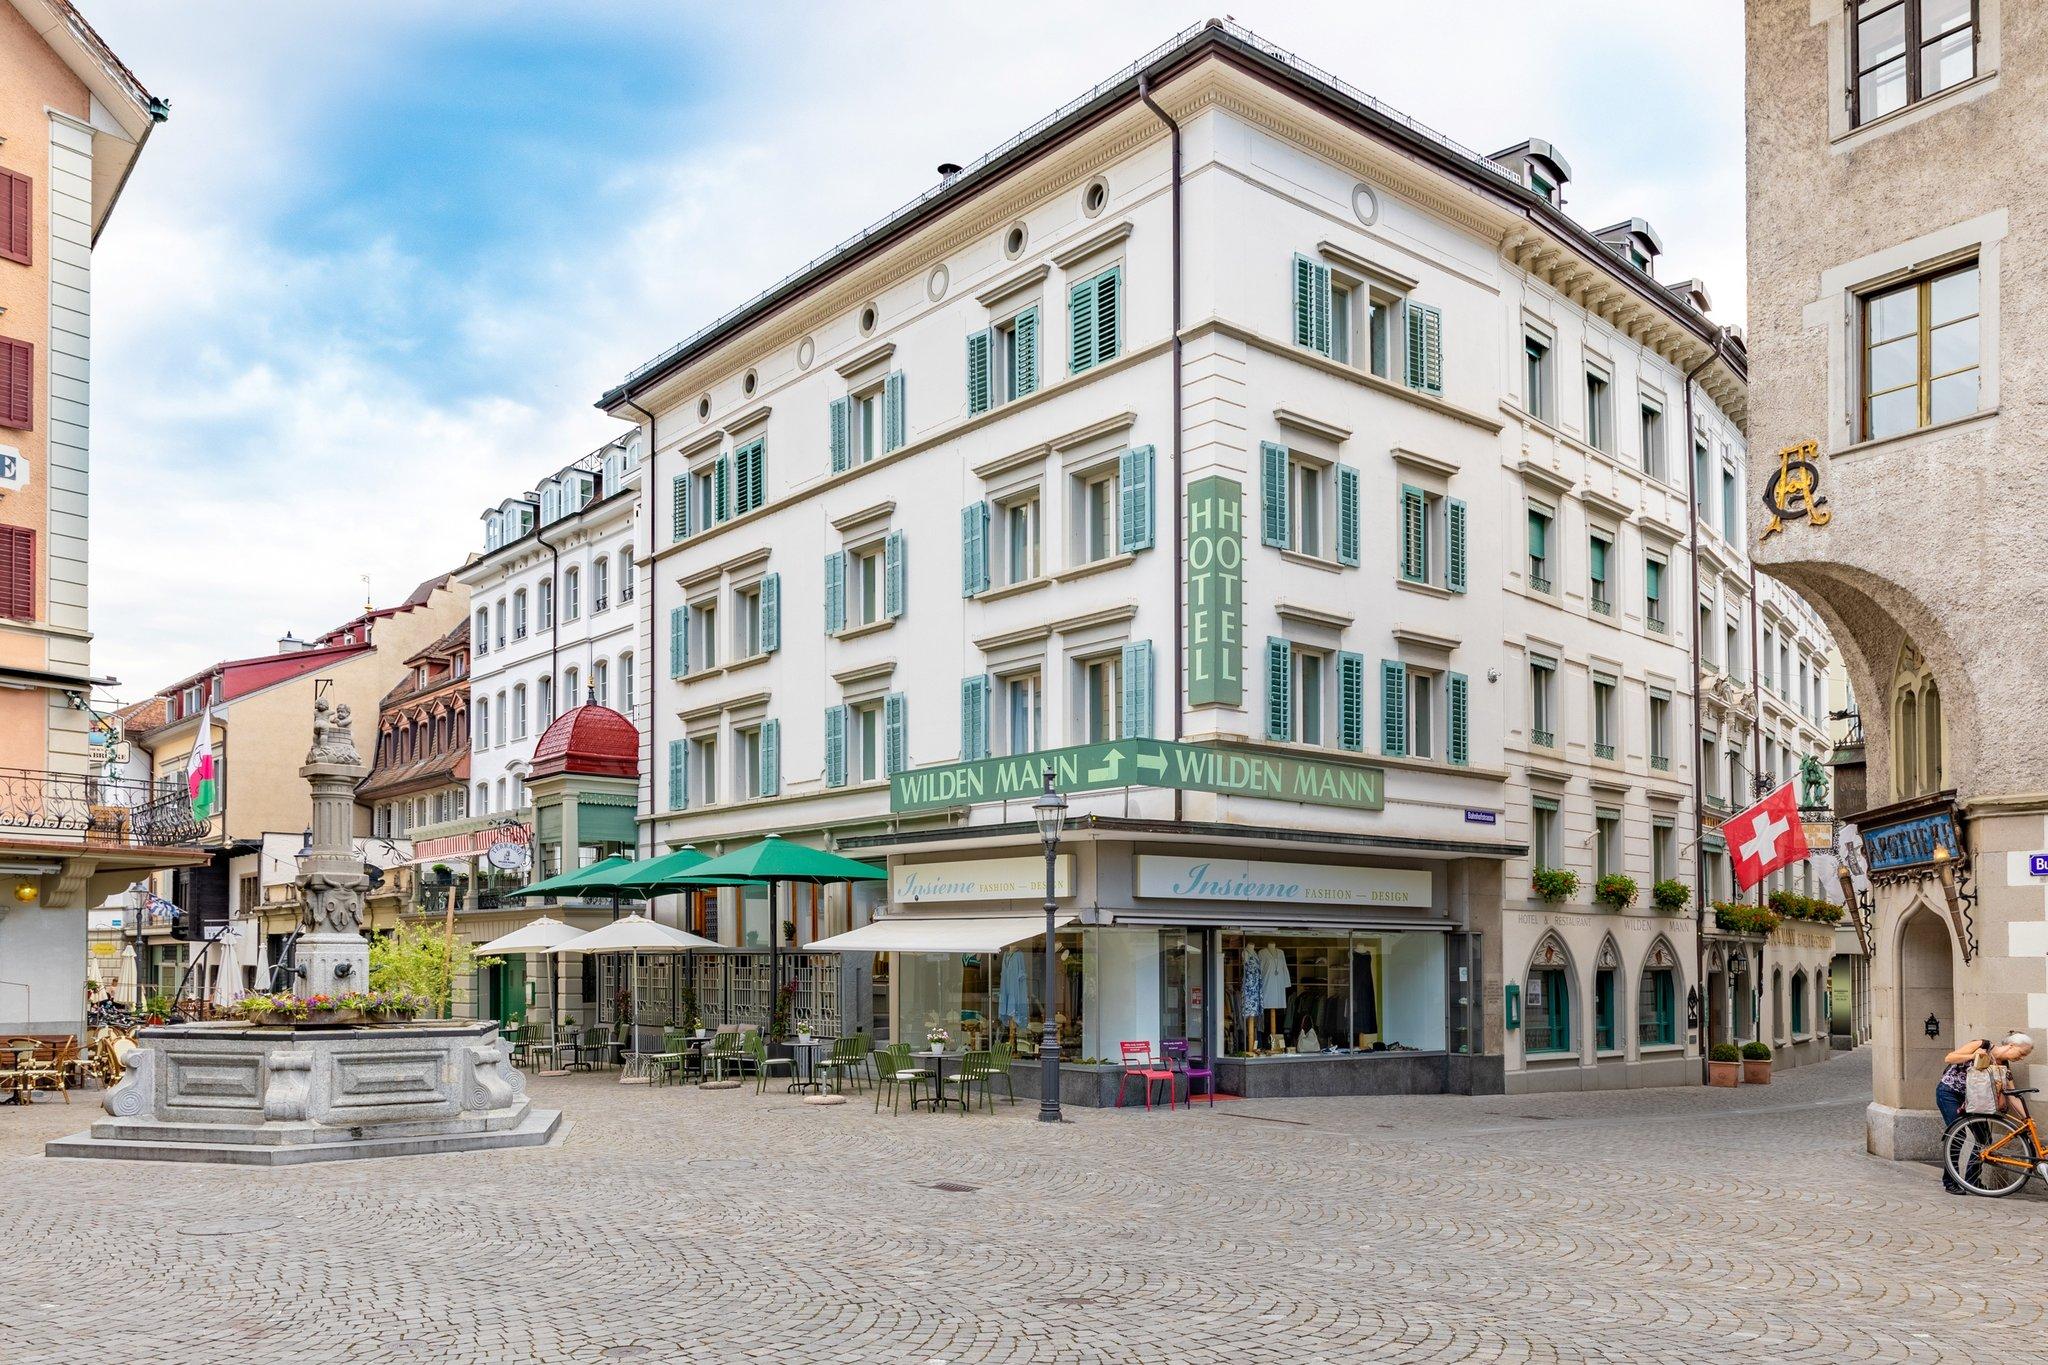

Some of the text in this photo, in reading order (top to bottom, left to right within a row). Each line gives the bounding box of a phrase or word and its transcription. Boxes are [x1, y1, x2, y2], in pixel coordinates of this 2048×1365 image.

[1189, 498, 1214, 681] HOTEL
[1216, 498, 1241, 682] HOTEL
[900, 754, 1078, 804] WILDEN MANN
[1175, 750, 1376, 803] WILDEN MANN
[491, 843, 524, 857] TERRASSE
[898, 871, 1065, 898] Insieme FASHION DESN
[1173, 863, 1409, 902] Insieme FASHION DESIGN
[1518, 914, 1538, 925] HOTEL
[1543, 915, 1549, 925] &
[1624, 918, 1652, 932] WILDEN
[1669, 920, 1690, 933] MANN
